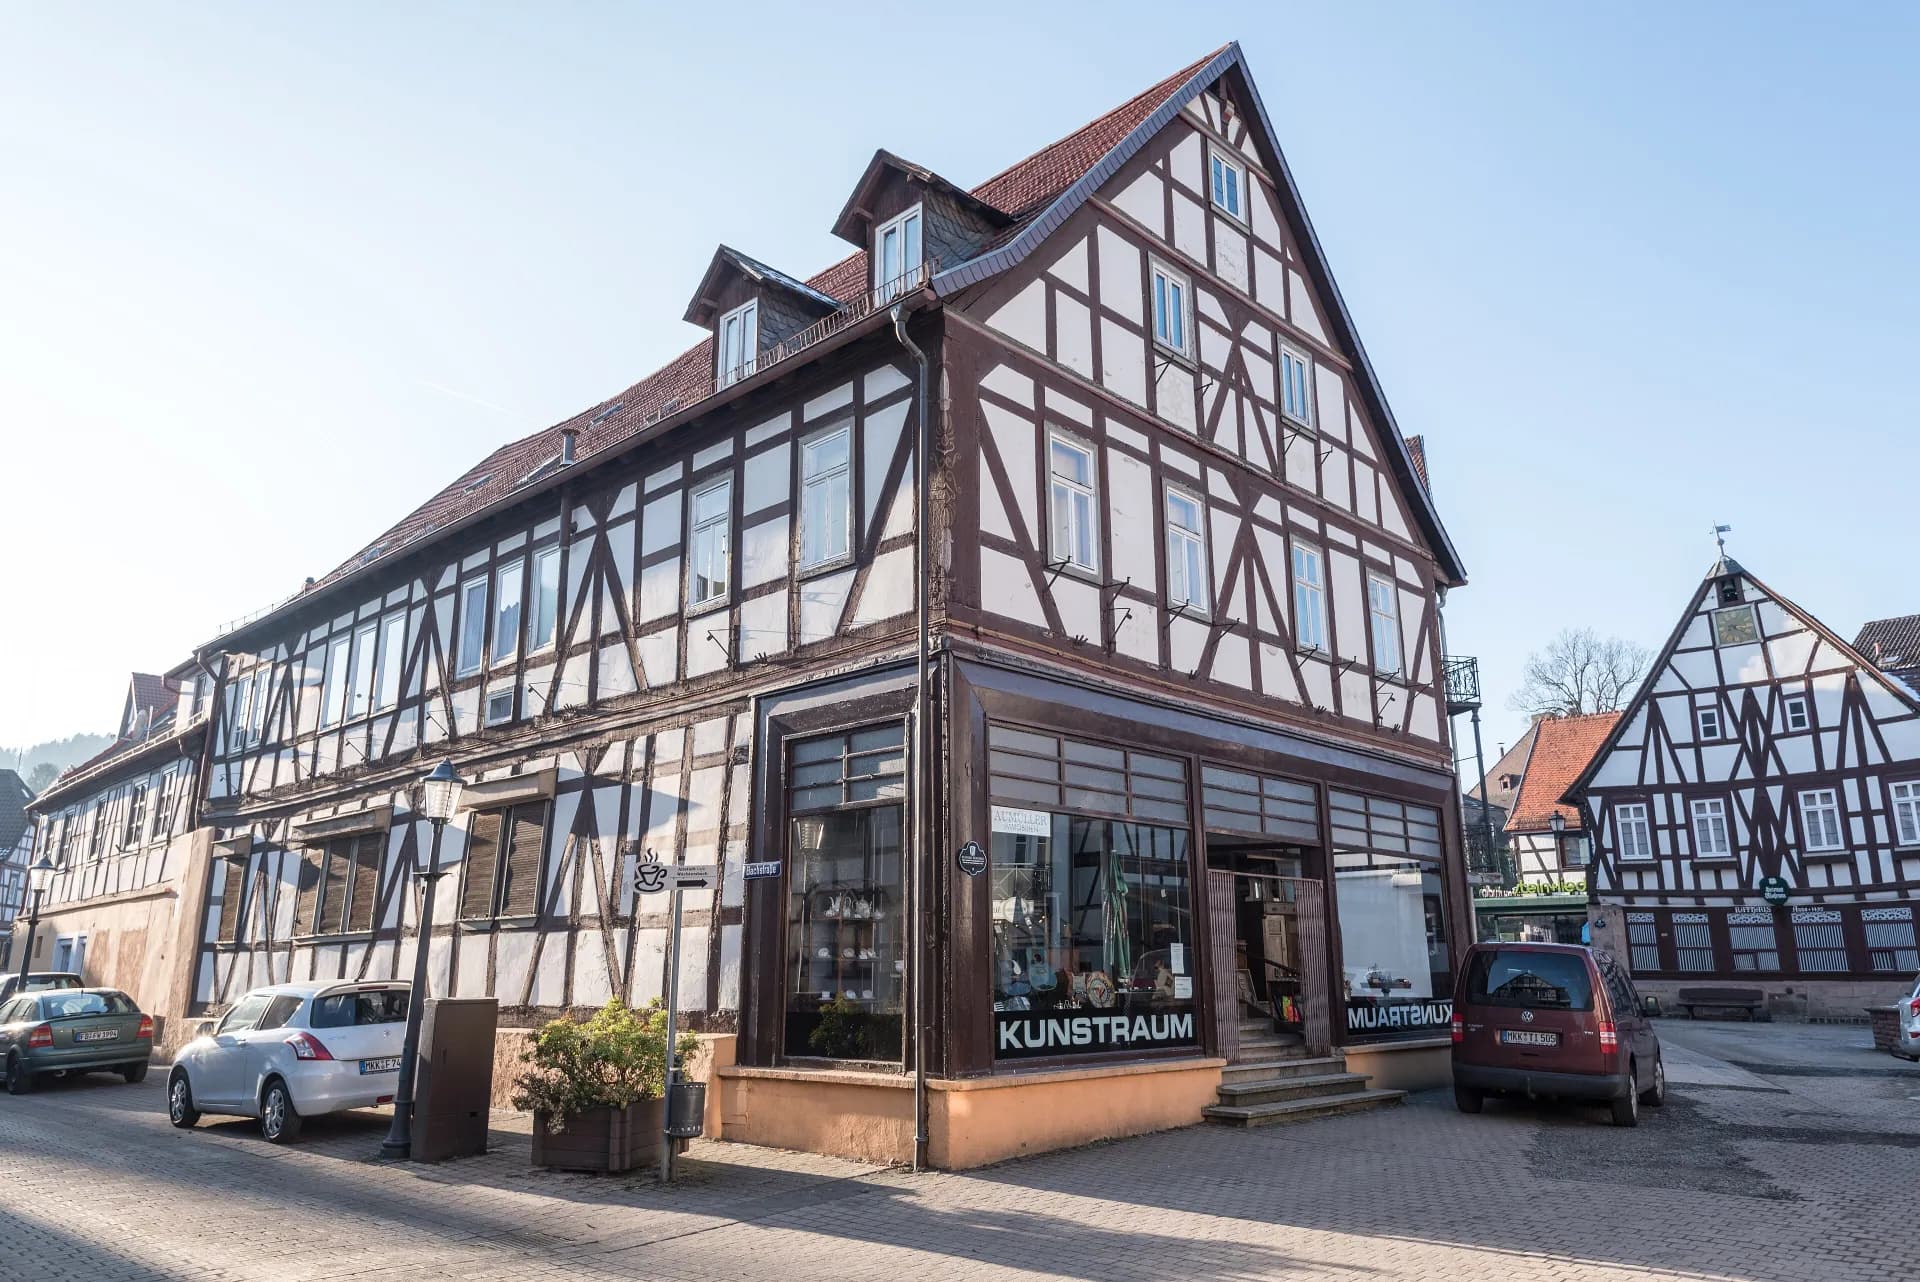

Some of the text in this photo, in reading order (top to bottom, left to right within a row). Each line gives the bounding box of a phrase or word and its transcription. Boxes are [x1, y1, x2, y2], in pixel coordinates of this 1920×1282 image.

[1000, 1013, 1193, 1050] KUNSTRAUM
[1506, 1031, 1523, 1042] MKK
[365, 1060, 381, 1071] MKK
